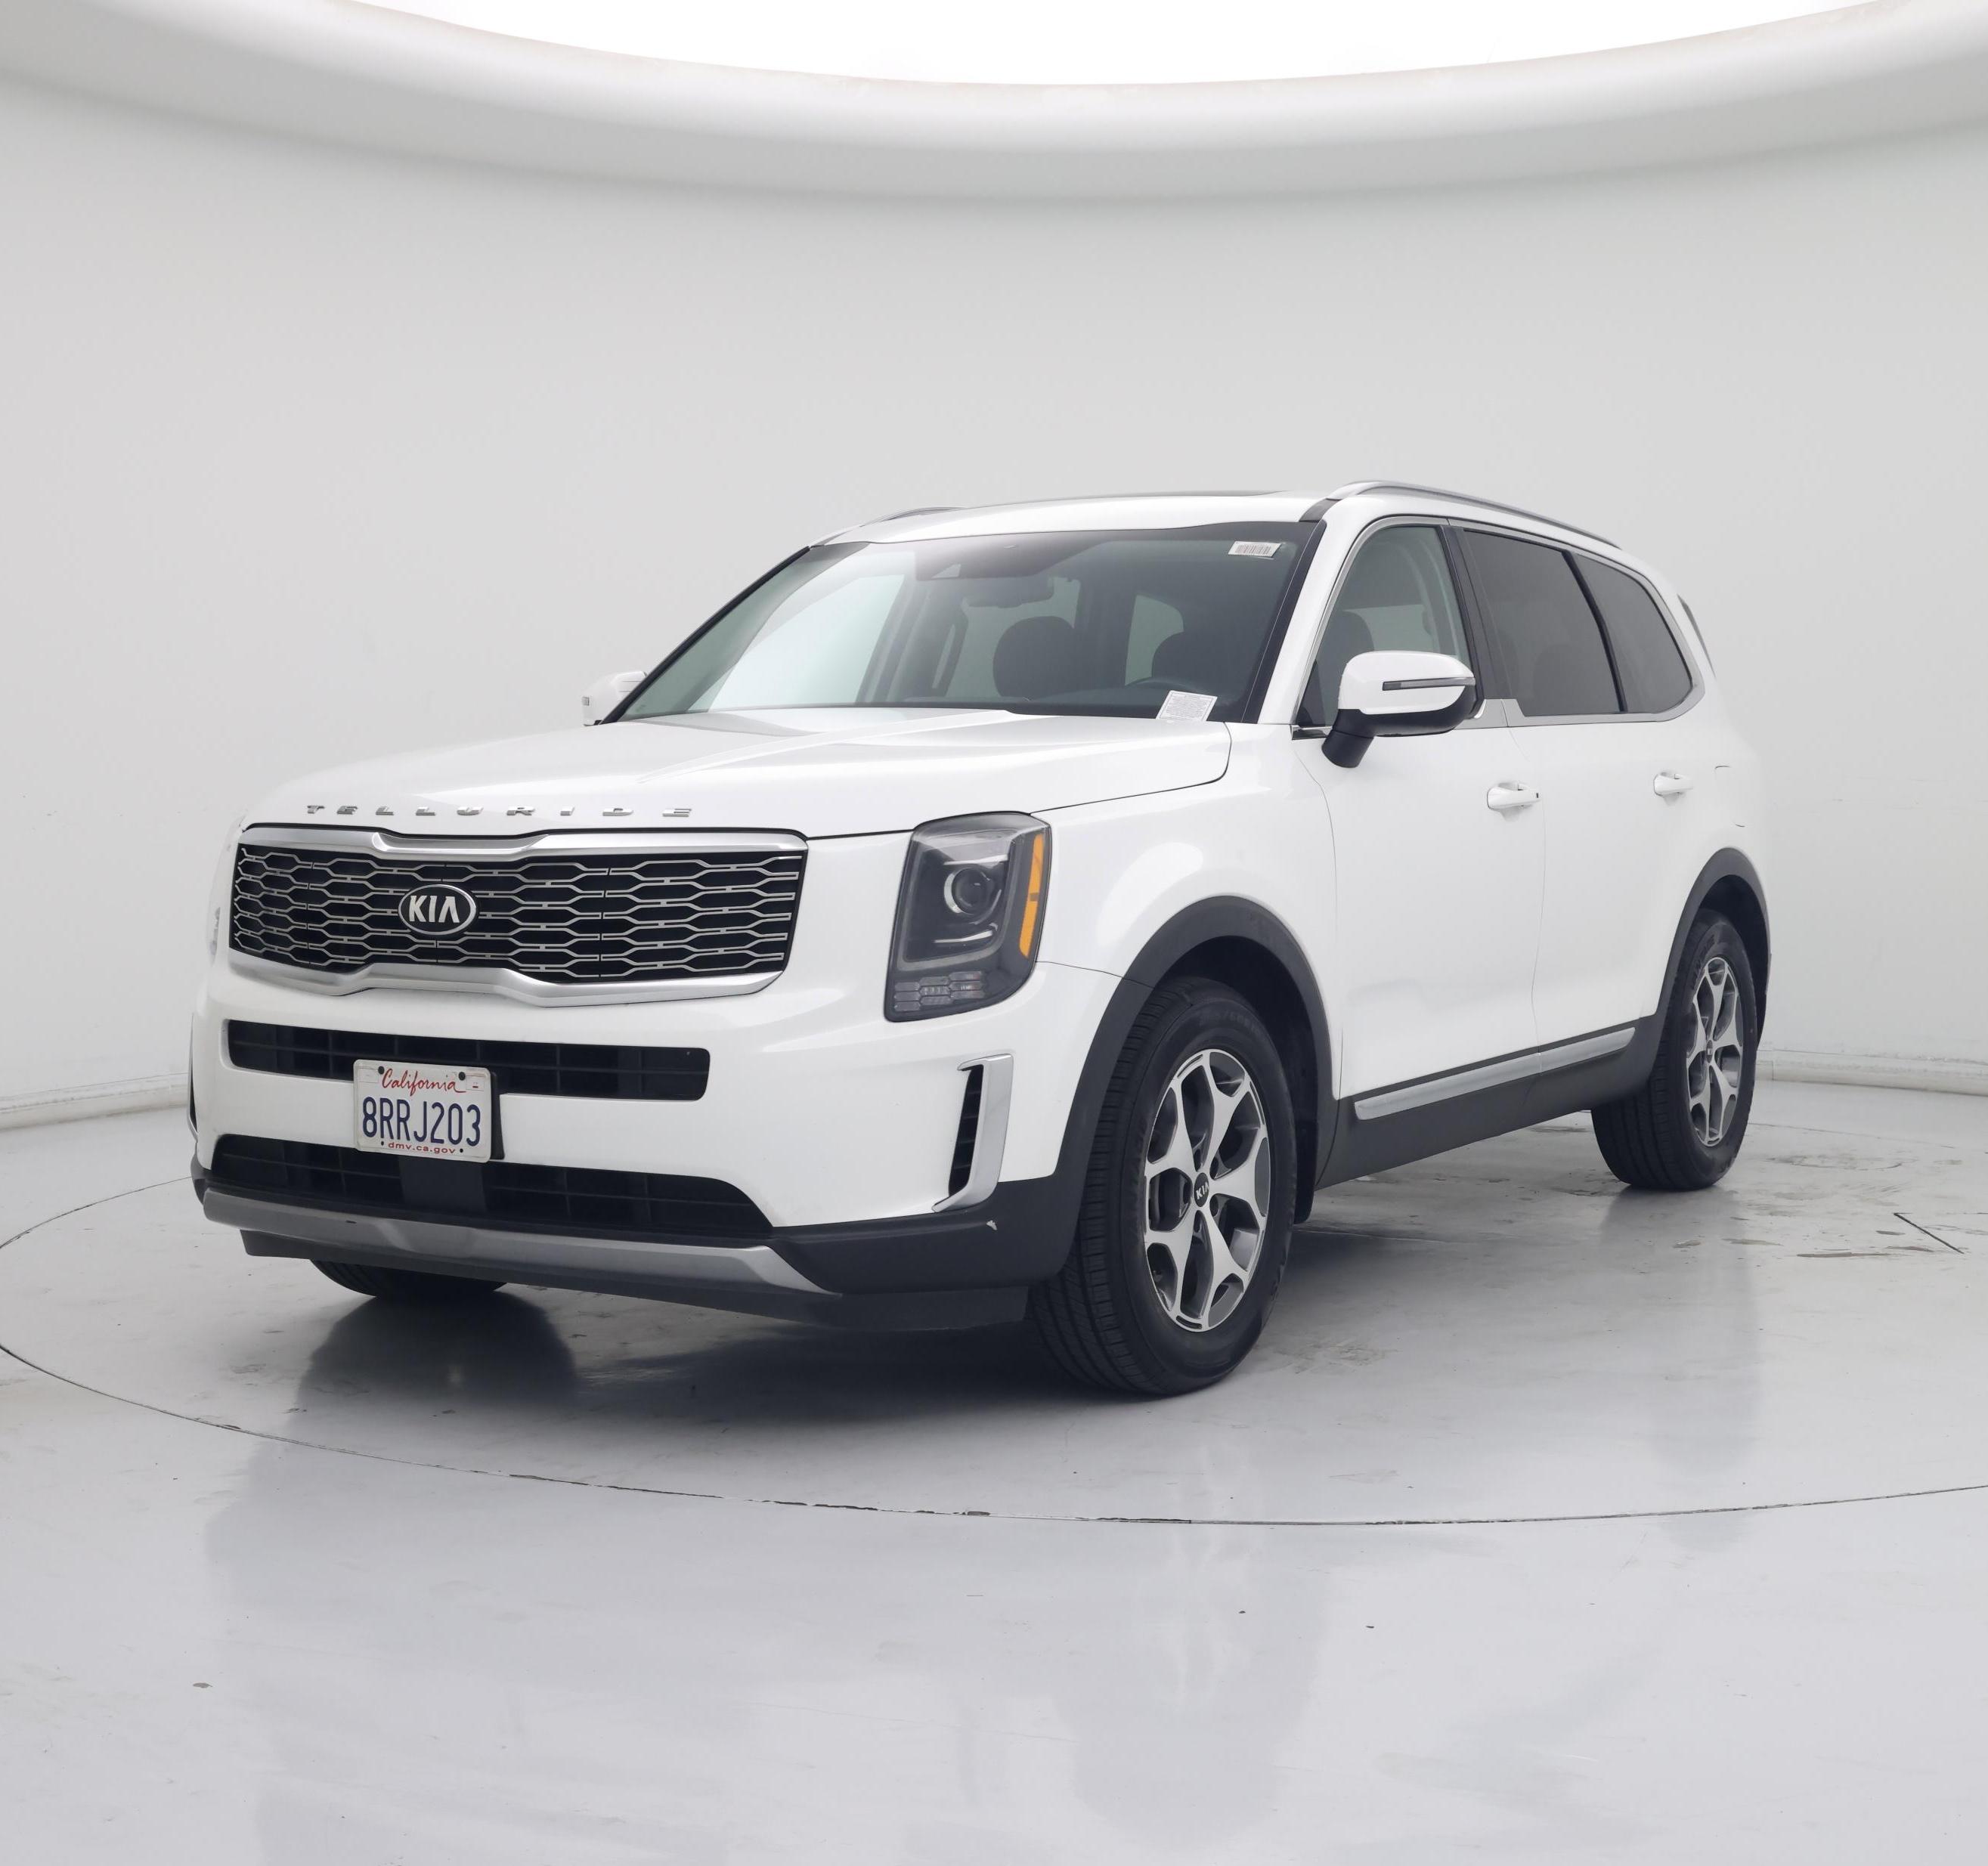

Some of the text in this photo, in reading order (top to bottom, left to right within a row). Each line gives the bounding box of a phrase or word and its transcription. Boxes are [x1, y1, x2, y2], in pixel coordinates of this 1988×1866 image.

[307, 805, 692, 818] TELLURIDE
[409, 895, 460, 924] KIA
[382, 1068, 466, 1097] California
[362, 1096, 481, 1147] 8RRJ203
[388, 1141, 456, 1154] dmv.ca.gov
[1196, 1181, 1209, 1200] KIA
